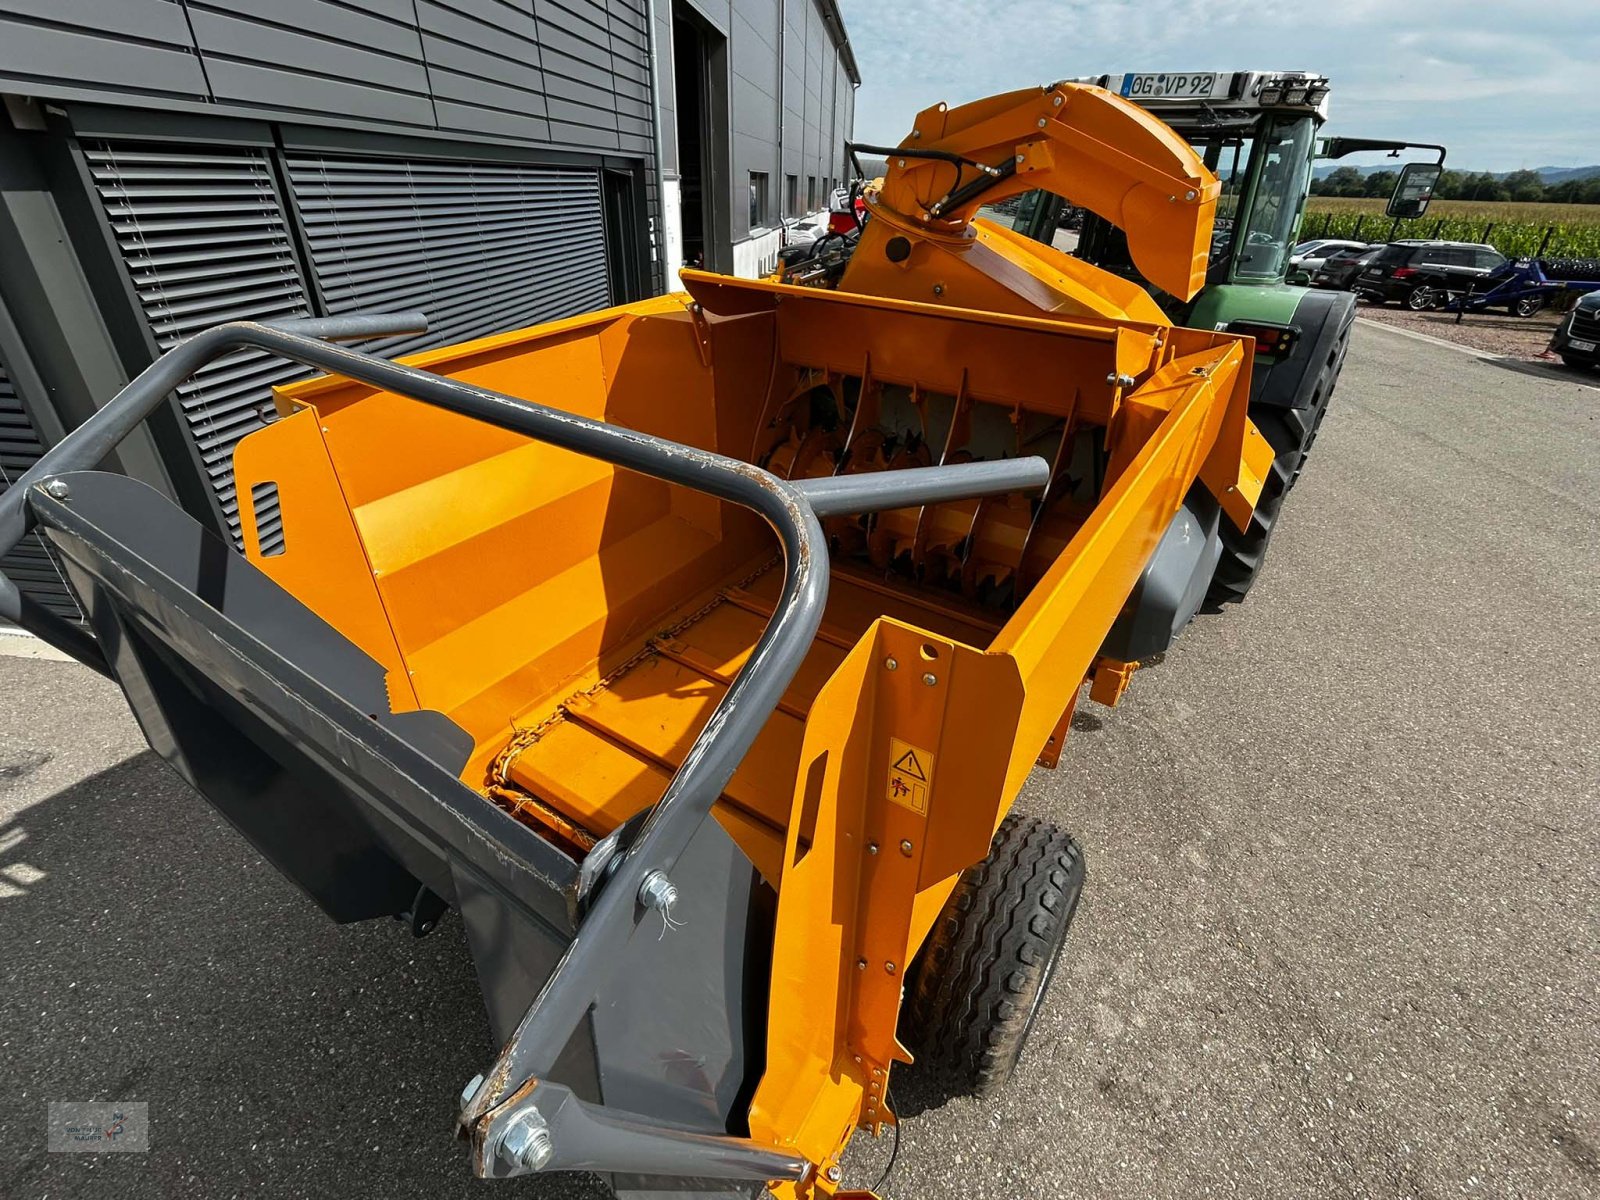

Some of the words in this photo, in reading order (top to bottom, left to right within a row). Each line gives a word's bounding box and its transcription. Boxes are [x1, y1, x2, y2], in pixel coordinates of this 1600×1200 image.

[1131, 76, 1154, 94] OG
[1164, 76, 1188, 94] VP
[1189, 75, 1213, 94] 92
